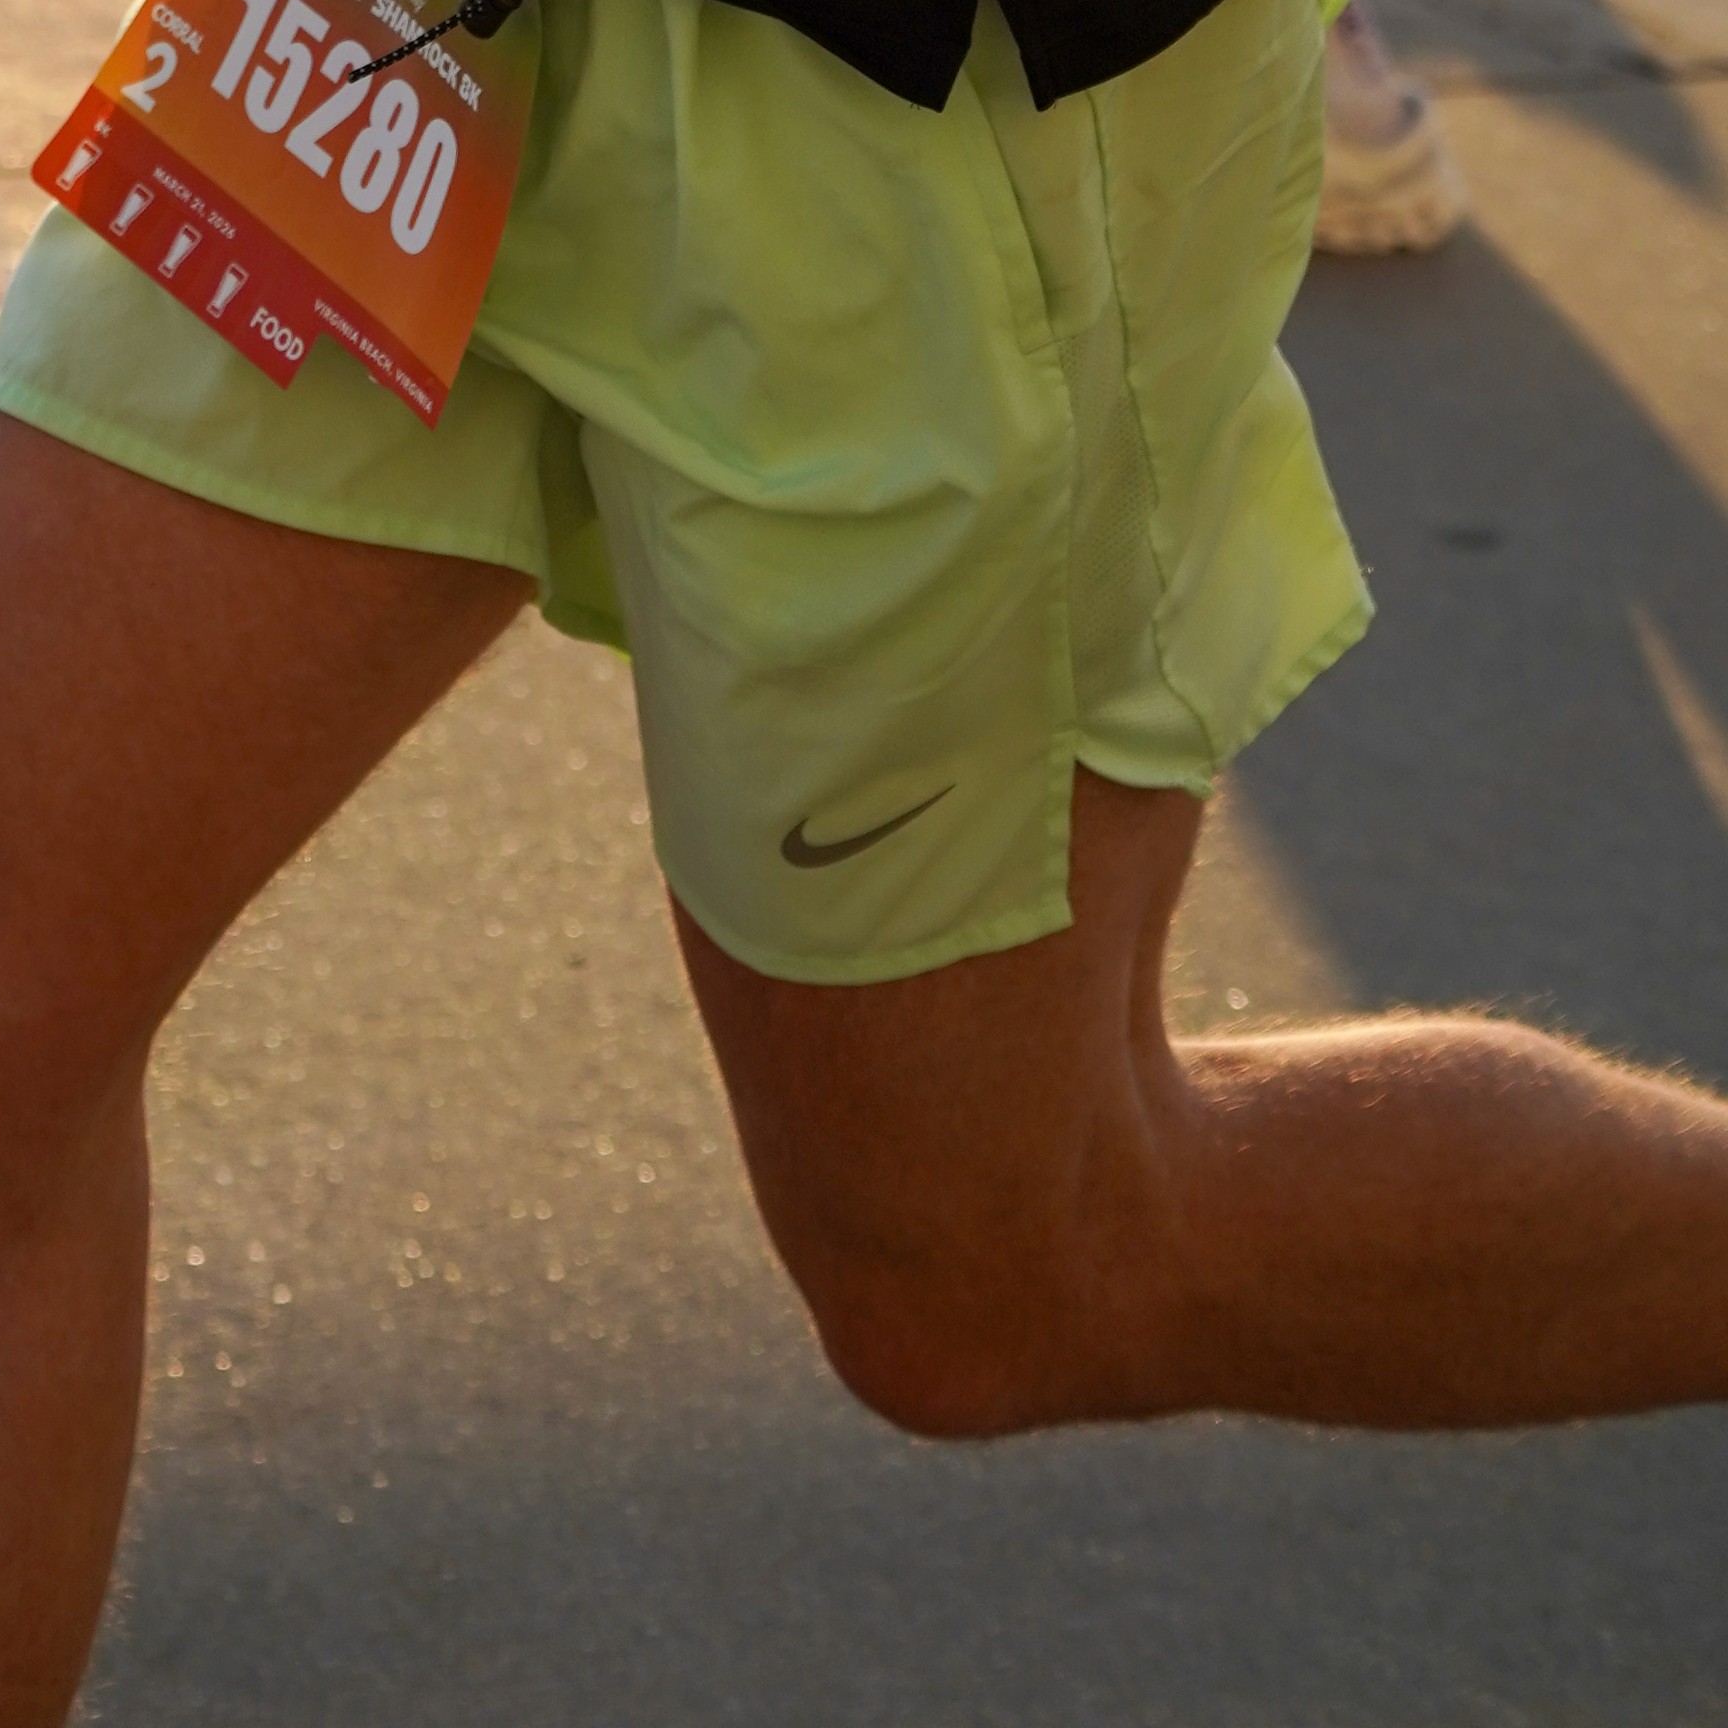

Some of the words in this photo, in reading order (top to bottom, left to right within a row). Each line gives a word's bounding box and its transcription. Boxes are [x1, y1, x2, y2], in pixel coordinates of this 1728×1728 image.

[150, 2, 205, 56] CORRAL
[119, 41, 178, 114] 2
[457, 73, 485, 113] 8K
[151, 166, 193, 204] MARCH
[206, 211, 238, 241] 2026
[249, 305, 306, 362] FOOD
[313, 298, 360, 345] VIRGINIA
[395, 367, 434, 414] VIRGINIA
